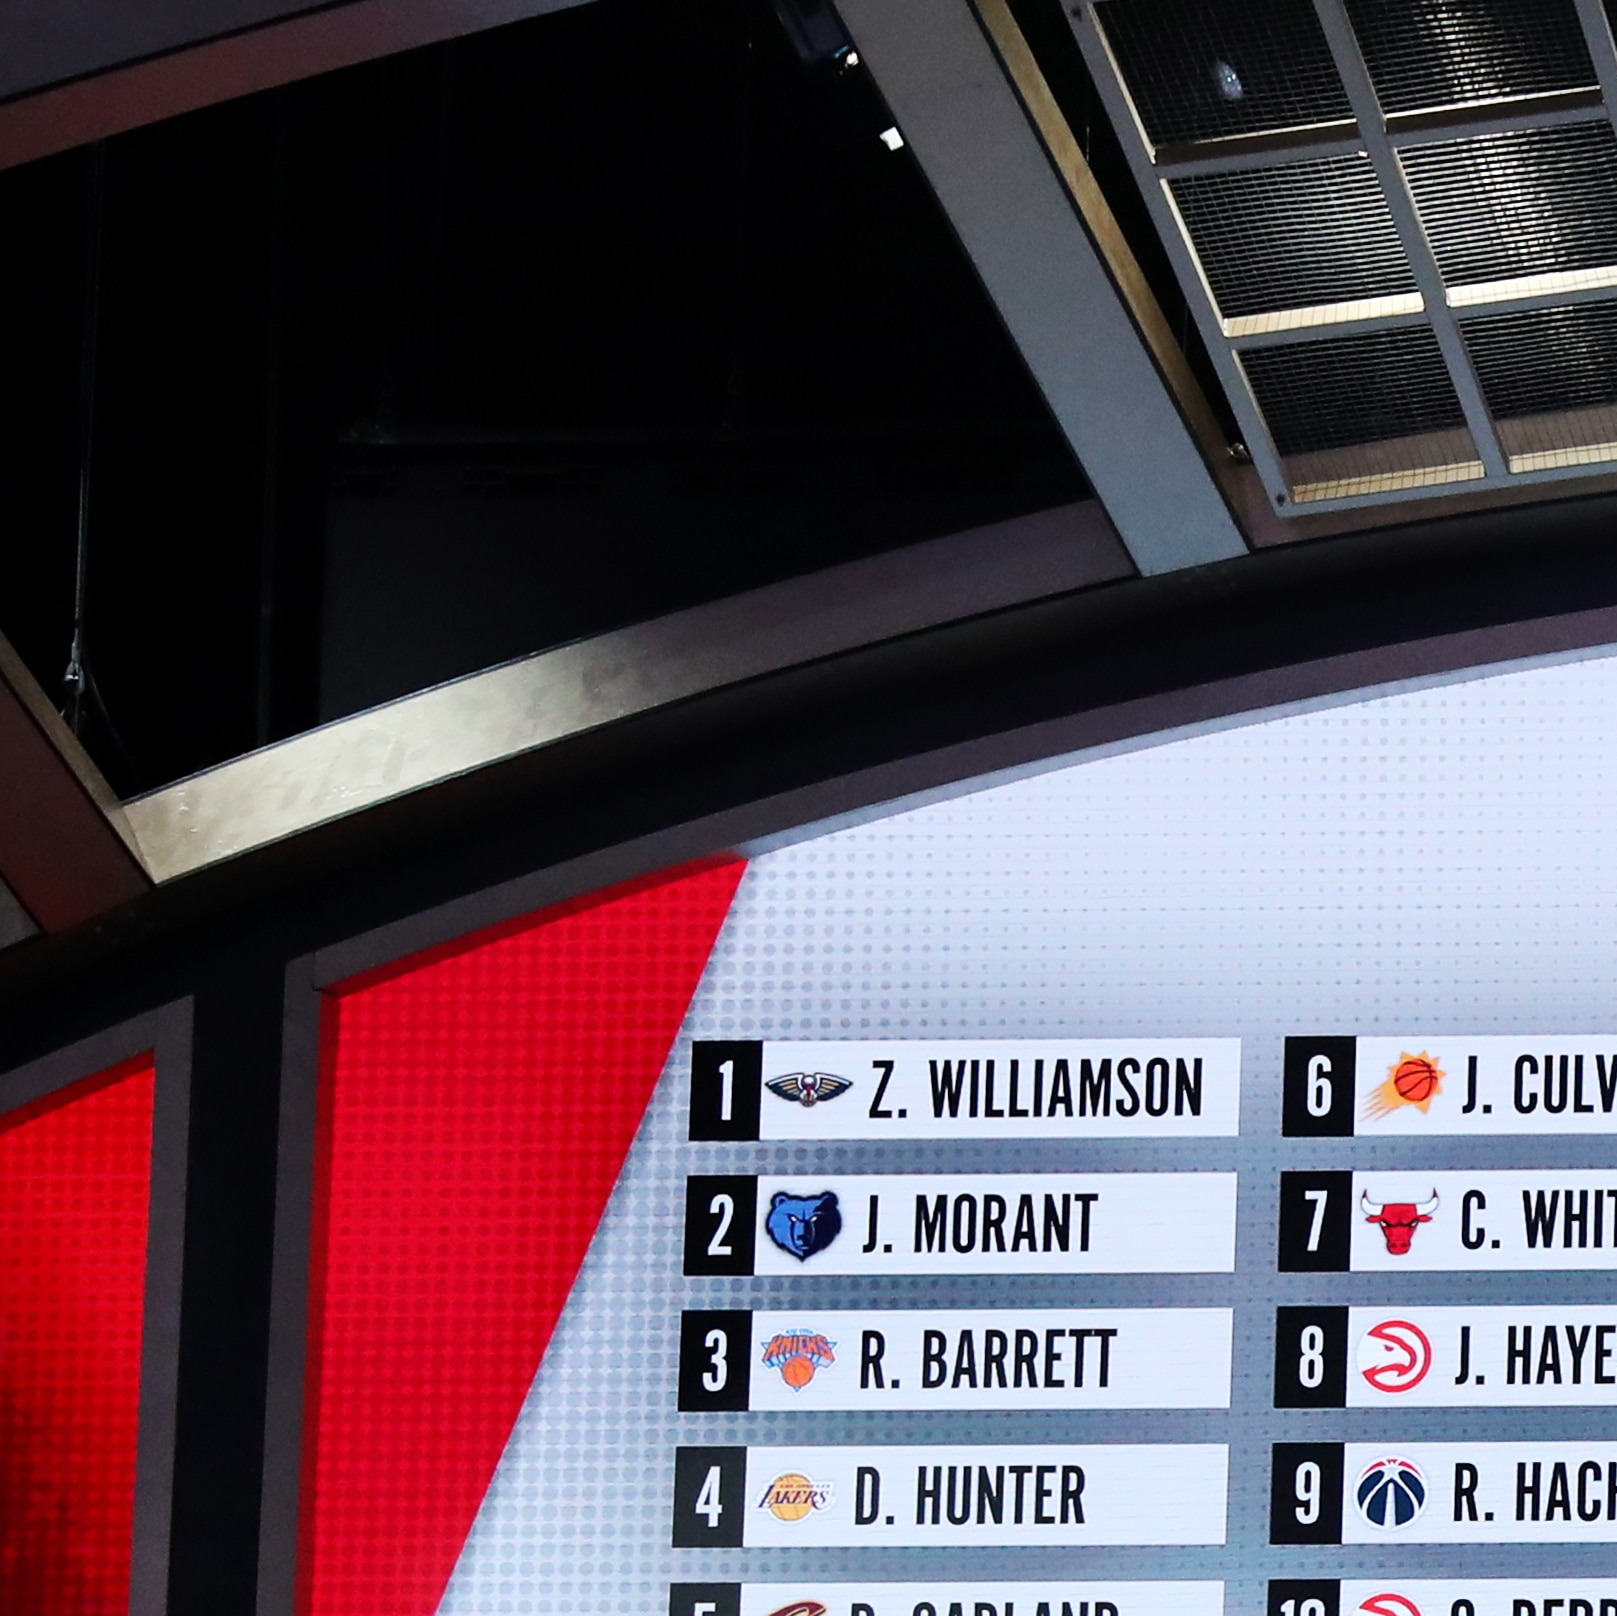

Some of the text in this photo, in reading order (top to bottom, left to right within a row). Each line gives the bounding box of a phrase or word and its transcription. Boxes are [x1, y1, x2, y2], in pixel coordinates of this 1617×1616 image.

[718, 1057, 1203, 1121] 1 Z. WILLIAMSON
[1306, 1054, 1332, 1117] 6
[1462, 1055, 1492, 1114] J.
[707, 1193, 1099, 1256] 2 J. MORANT
[1304, 1190, 1328, 1252] 7
[1461, 1189, 1501, 1250] C.
[702, 1328, 1118, 1392] 3 R. BARRETT
[1299, 1325, 1324, 1388] 8
[1454, 1325, 1485, 1385] J.
[695, 1465, 1086, 1528] 4 D. HUNTER
[758, 1484, 829, 1510] LAKERS
[1295, 1461, 1321, 1525] 9
[1453, 1462, 1494, 1522] R.
